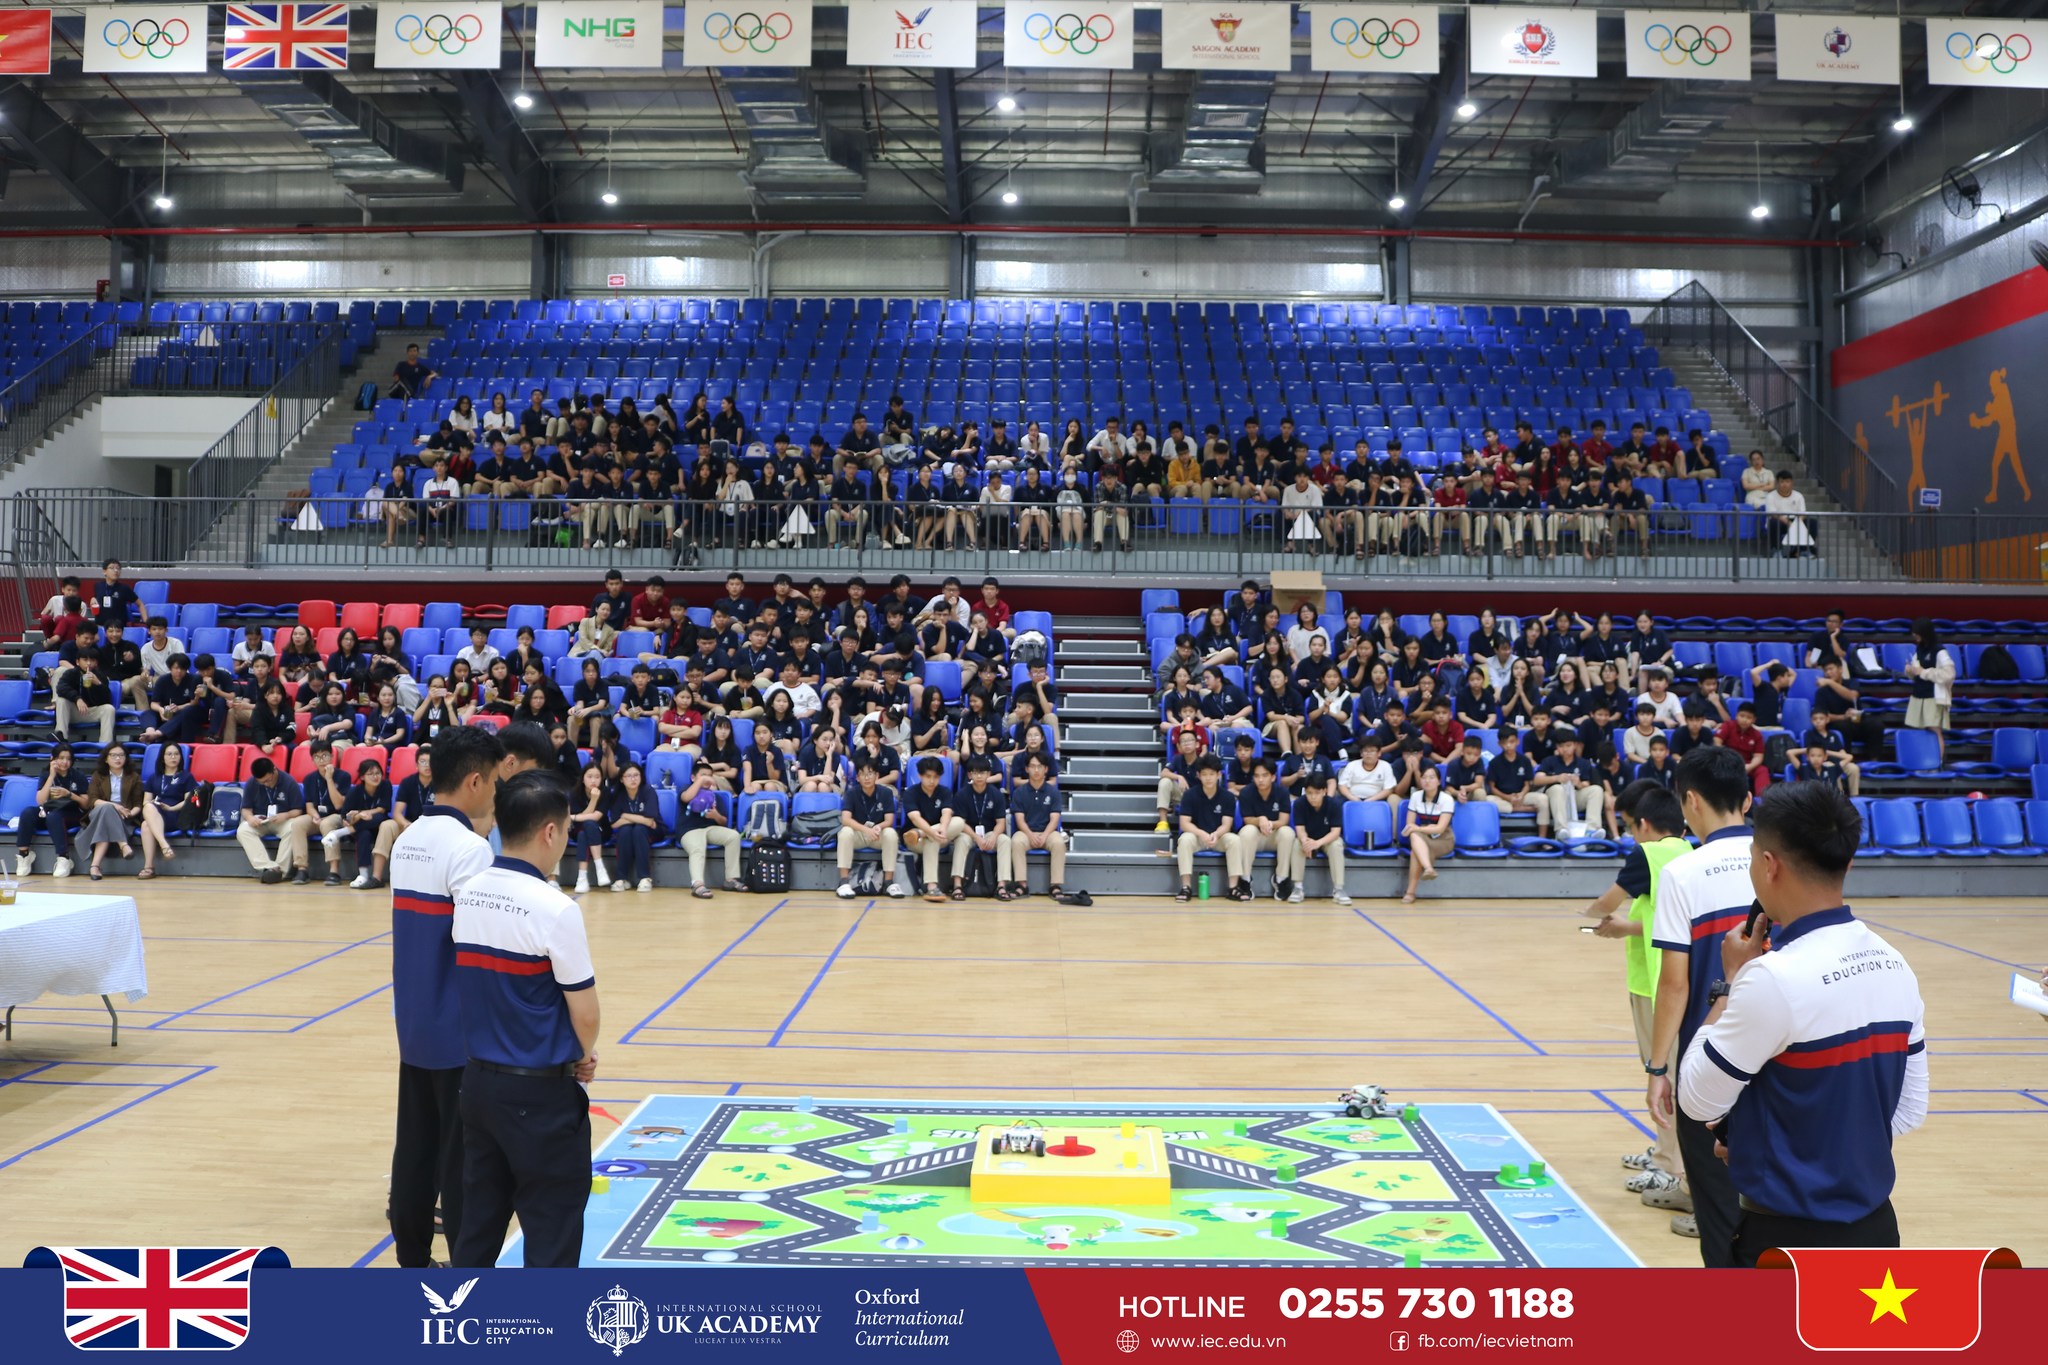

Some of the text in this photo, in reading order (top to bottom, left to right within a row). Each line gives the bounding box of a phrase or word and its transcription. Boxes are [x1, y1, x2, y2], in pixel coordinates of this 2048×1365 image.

[564, 18, 635, 37] NHG
[895, 32, 933, 50] IEC
[1704, 863, 1749, 877] EDUCAT
[468, 890, 515, 903] INTERNATIONAL
[456, 897, 531, 917] EDUCATION CITY
[1838, 948, 1889, 964] INTERNATIONAL
[1821, 959, 1905, 986] EDUCATION CITY
